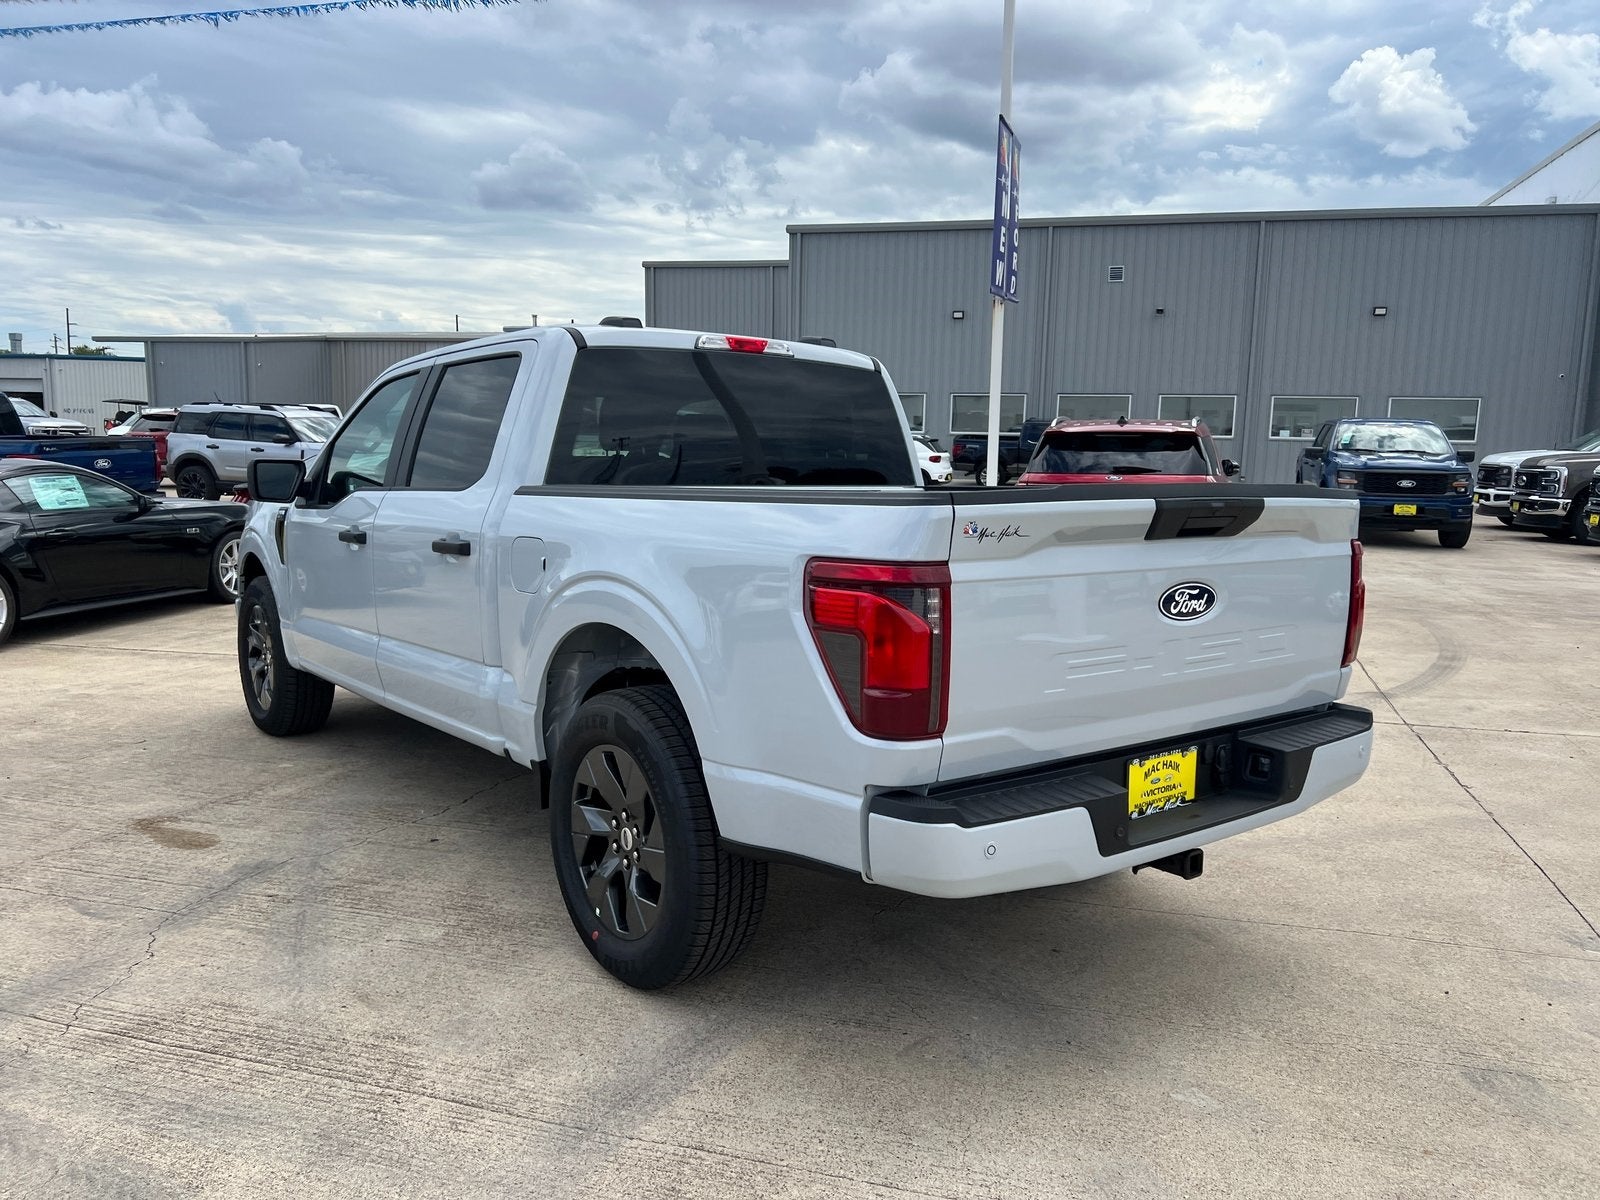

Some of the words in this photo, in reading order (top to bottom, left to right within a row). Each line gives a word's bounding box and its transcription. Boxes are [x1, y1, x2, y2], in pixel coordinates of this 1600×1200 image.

[995, 191, 1010, 287] NEW
[1010, 204, 1020, 294] FORD
[977, 527, 997, 544] Mac
[997, 525, 1024, 543] Haik
[1170, 588, 1208, 614] Ford
[1143, 761, 1161, 781] MAC
[1162, 760, 1180, 774] HAIK
[1145, 783, 1177, 797] VICTORIA
[1144, 804, 1163, 816] Mac
